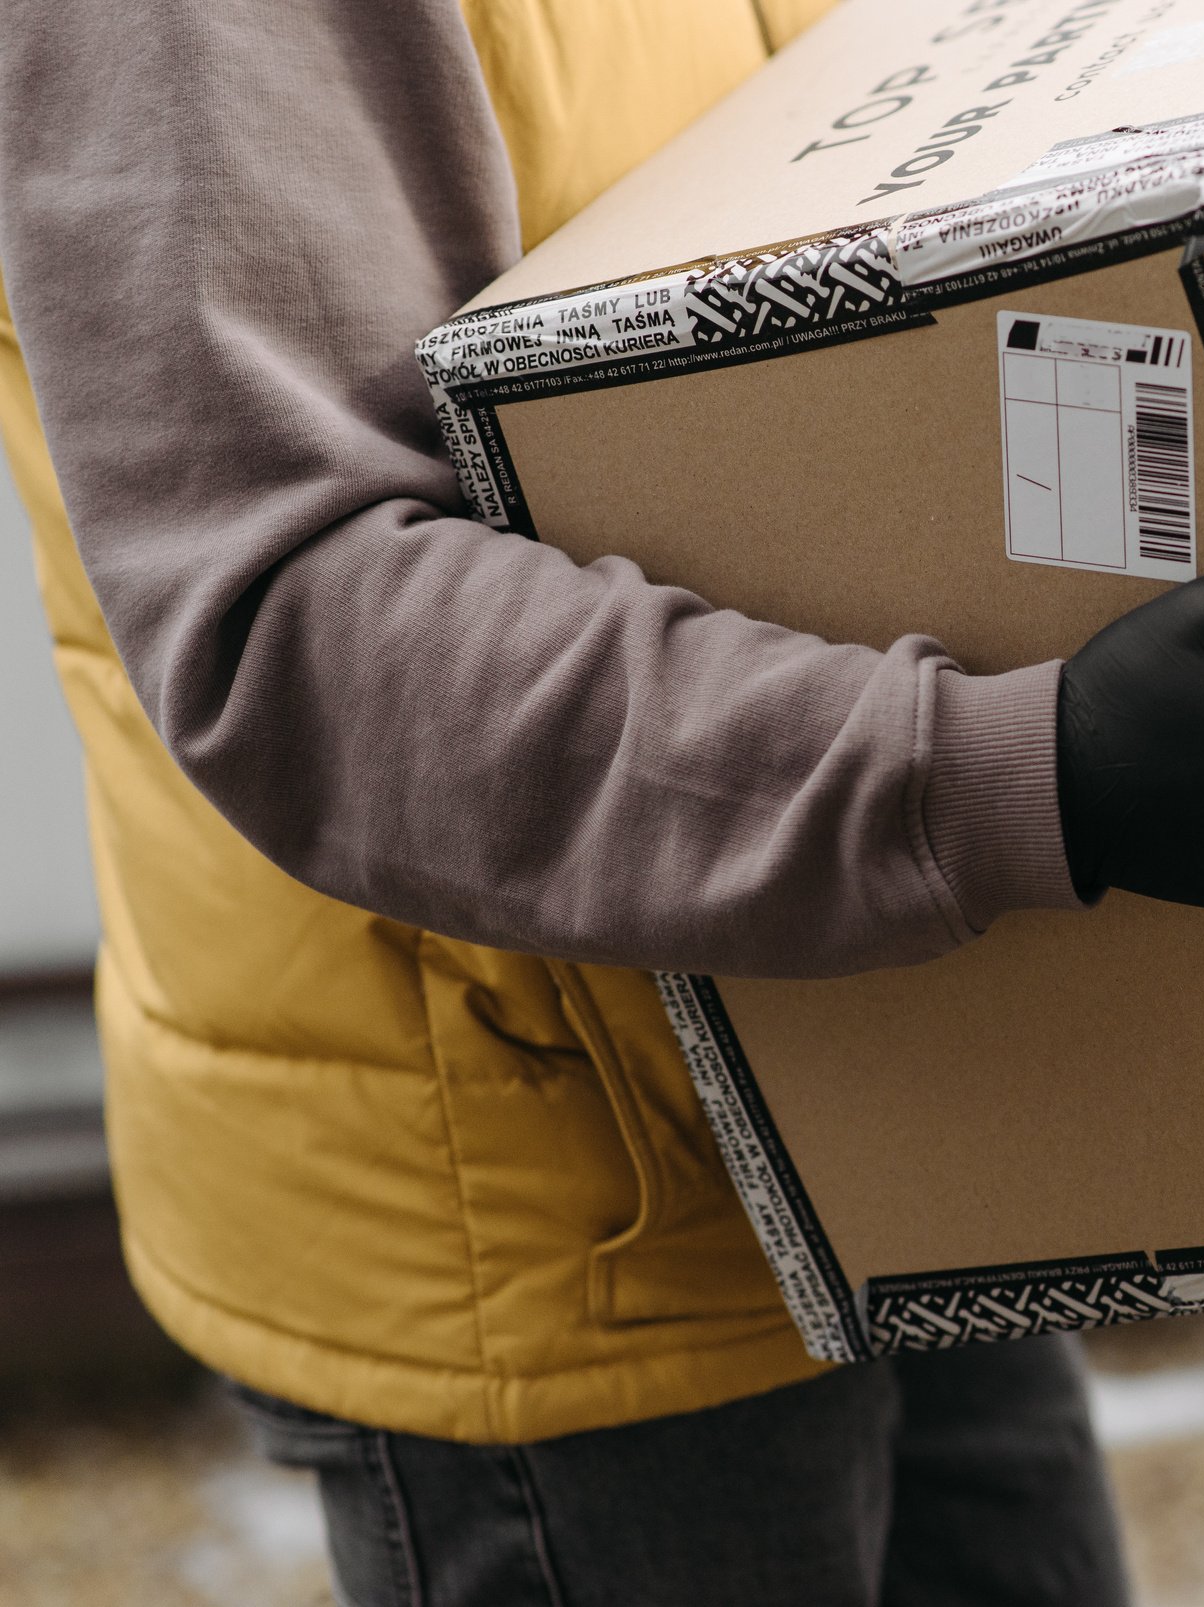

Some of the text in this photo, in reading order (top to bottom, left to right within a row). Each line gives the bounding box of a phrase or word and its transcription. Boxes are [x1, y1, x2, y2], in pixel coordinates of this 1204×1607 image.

[1053, 29, 1147, 101] contact
[791, 64, 938, 163] TOP
[856, 98, 1014, 206] YOUR
[979, 224, 1061, 260] UWAGA!!!
[1039, 252, 1064, 268] 10/14
[945, 273, 984, 292] 6177103
[987, 269, 997, 281] 42
[557, 294, 621, 325] TAŚMY
[633, 287, 671, 310] LUB
[450, 327, 541, 366] FIRMOWEJ
[555, 322, 601, 350] INNĄ
[611, 306, 675, 341] TAŚMĄ
[484, 359, 500, 378] W
[603, 325, 680, 362] KURIERA
[510, 381, 522, 393] 42
[523, 374, 561, 392] 6177103
[606, 365, 618, 378] 42
[620, 363, 636, 376] 617
[638, 360, 650, 372] 71
[652, 358, 666, 370] 22/
[790, 322, 838, 342] UWAGA!!!
[841, 317, 868, 333] PRZY
[869, 308, 907, 326] BRAKU
[488, 439, 500, 454] SA
[468, 450, 503, 518] NALEŻY
[493, 456, 513, 493] REDAN
[668, 970, 713, 1043] KURIERA
[744, 1144, 763, 1159] W
